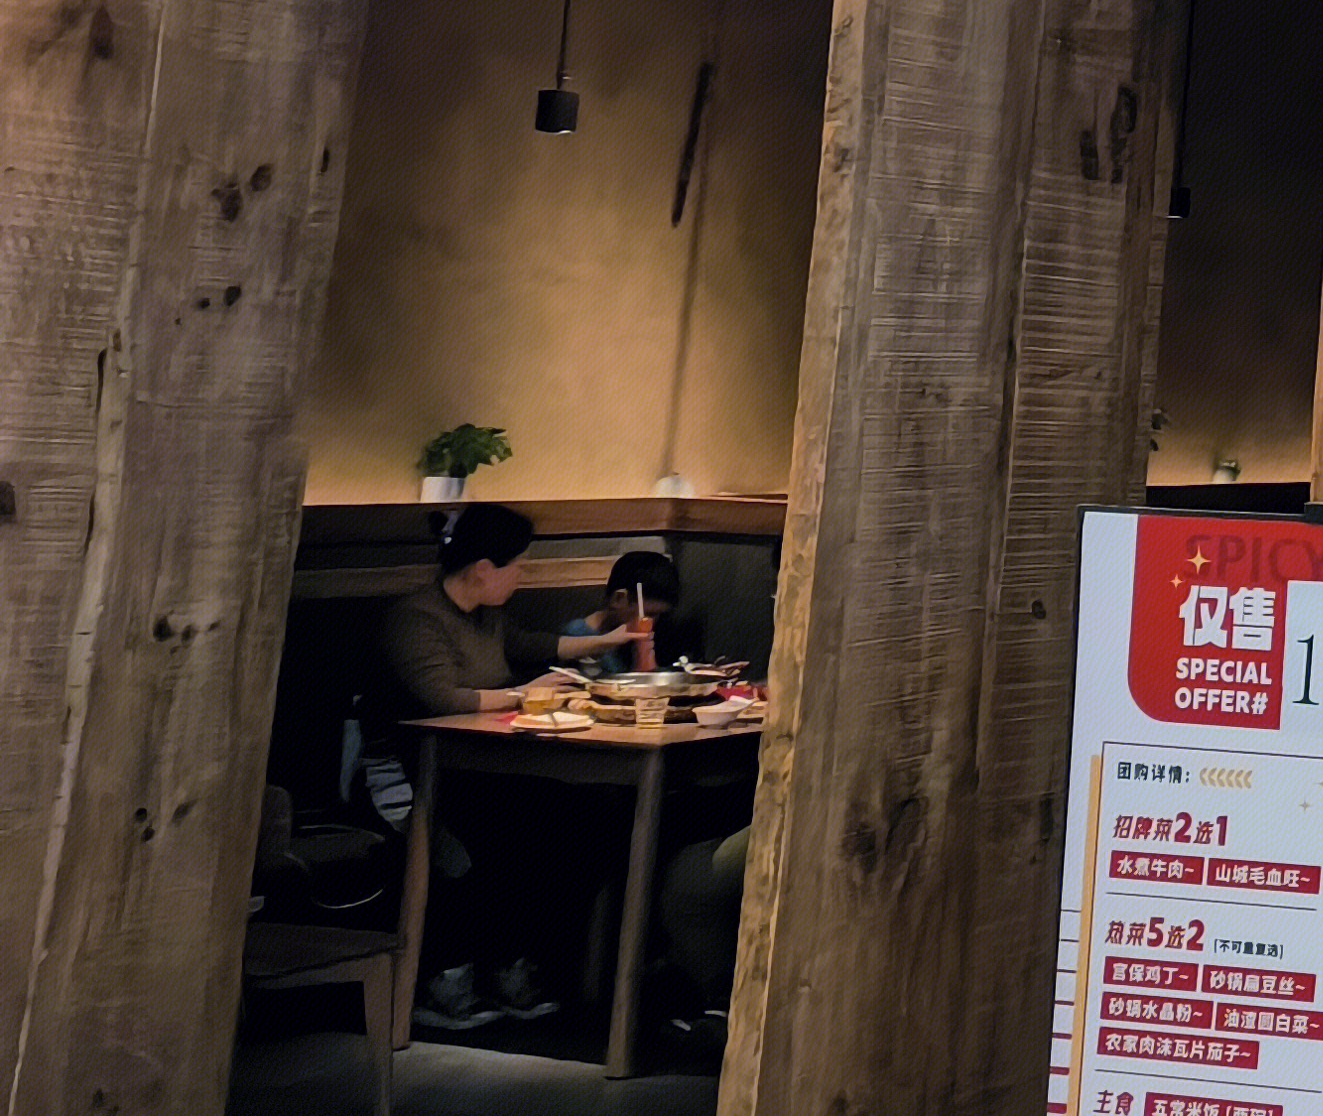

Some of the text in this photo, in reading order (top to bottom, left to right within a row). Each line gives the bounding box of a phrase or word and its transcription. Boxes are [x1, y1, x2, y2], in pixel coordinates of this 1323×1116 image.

[1178, 585, 1276, 652] 仅售
[1176, 657, 1273, 685] SPECIAL
[1174, 686, 1269, 716] OFFER#
[1112, 811, 1229, 847] 招牌菜2选1
